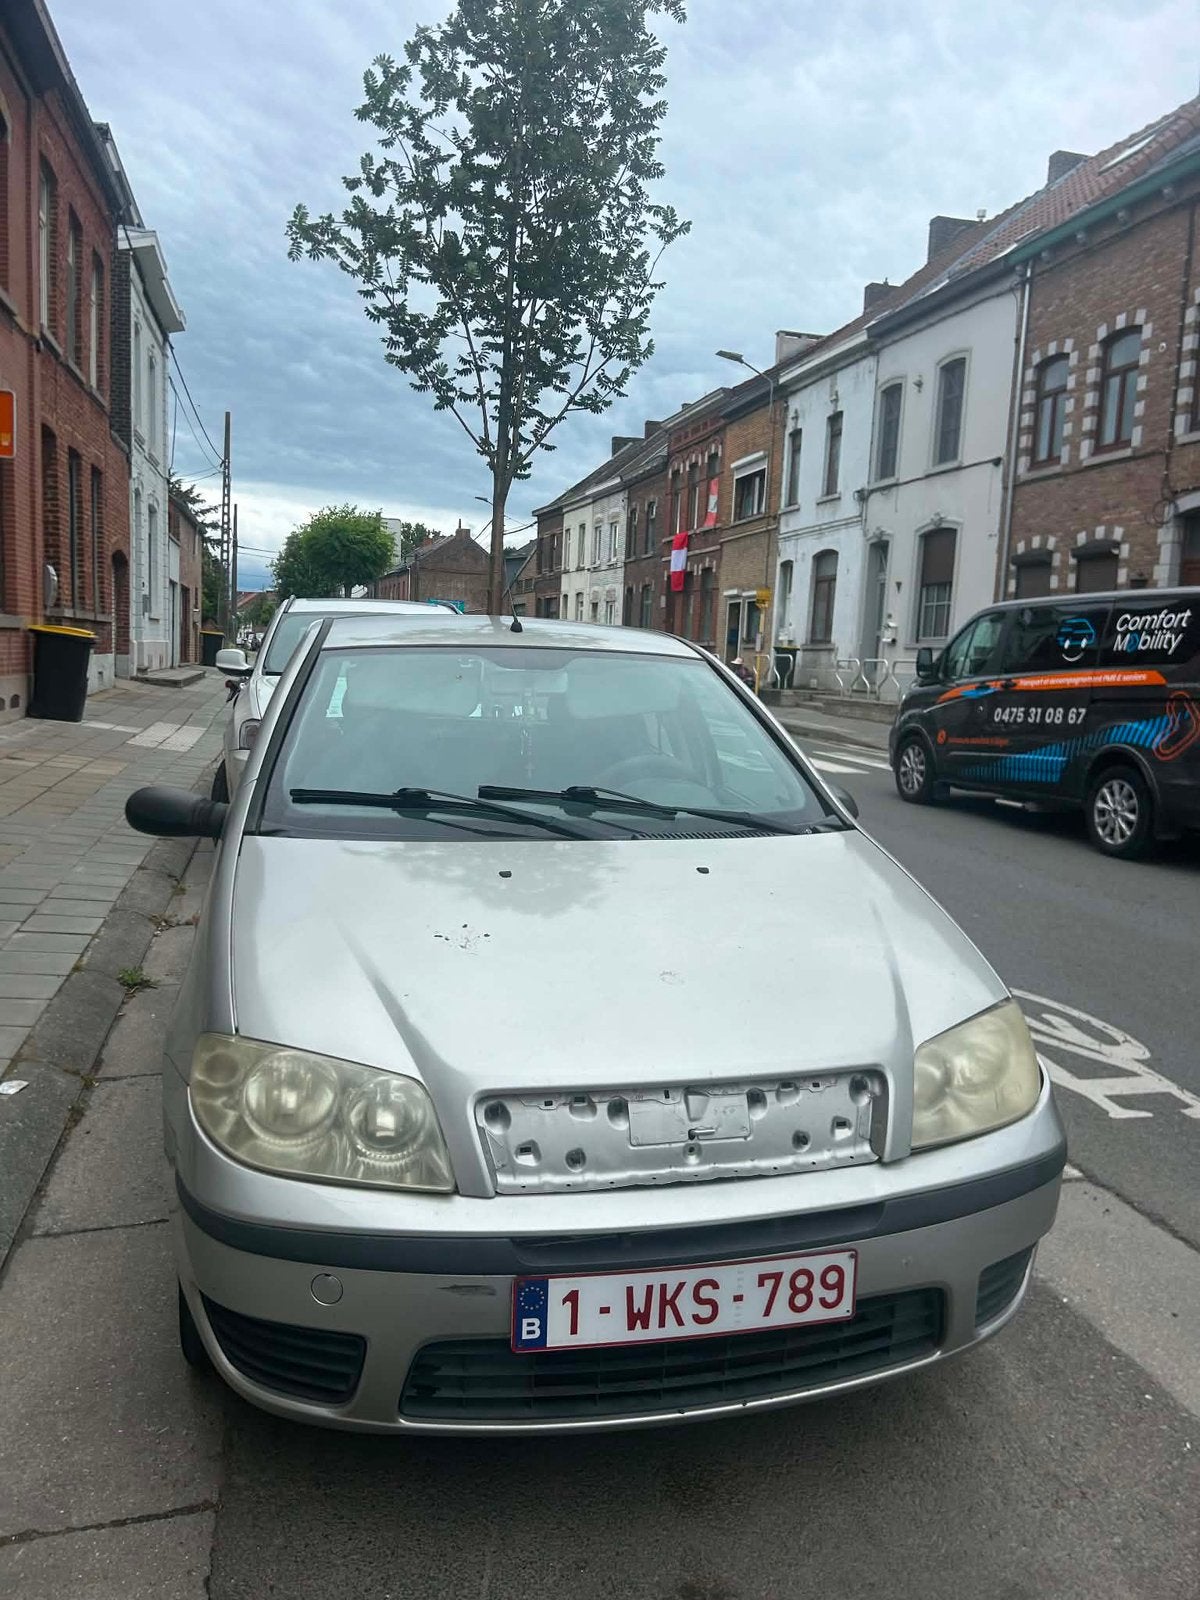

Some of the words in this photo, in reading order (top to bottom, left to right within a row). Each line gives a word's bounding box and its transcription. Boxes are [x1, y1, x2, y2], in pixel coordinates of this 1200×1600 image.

[1116, 609, 1192, 632] Comfort
[1113, 629, 1184, 655] Mobility
[994, 707, 1025, 723] 0475
[1027, 707, 1042, 723] 31
[1045, 707, 1064, 724] 08
[1068, 708, 1087, 724] 67
[521, 1317, 541, 1340] B
